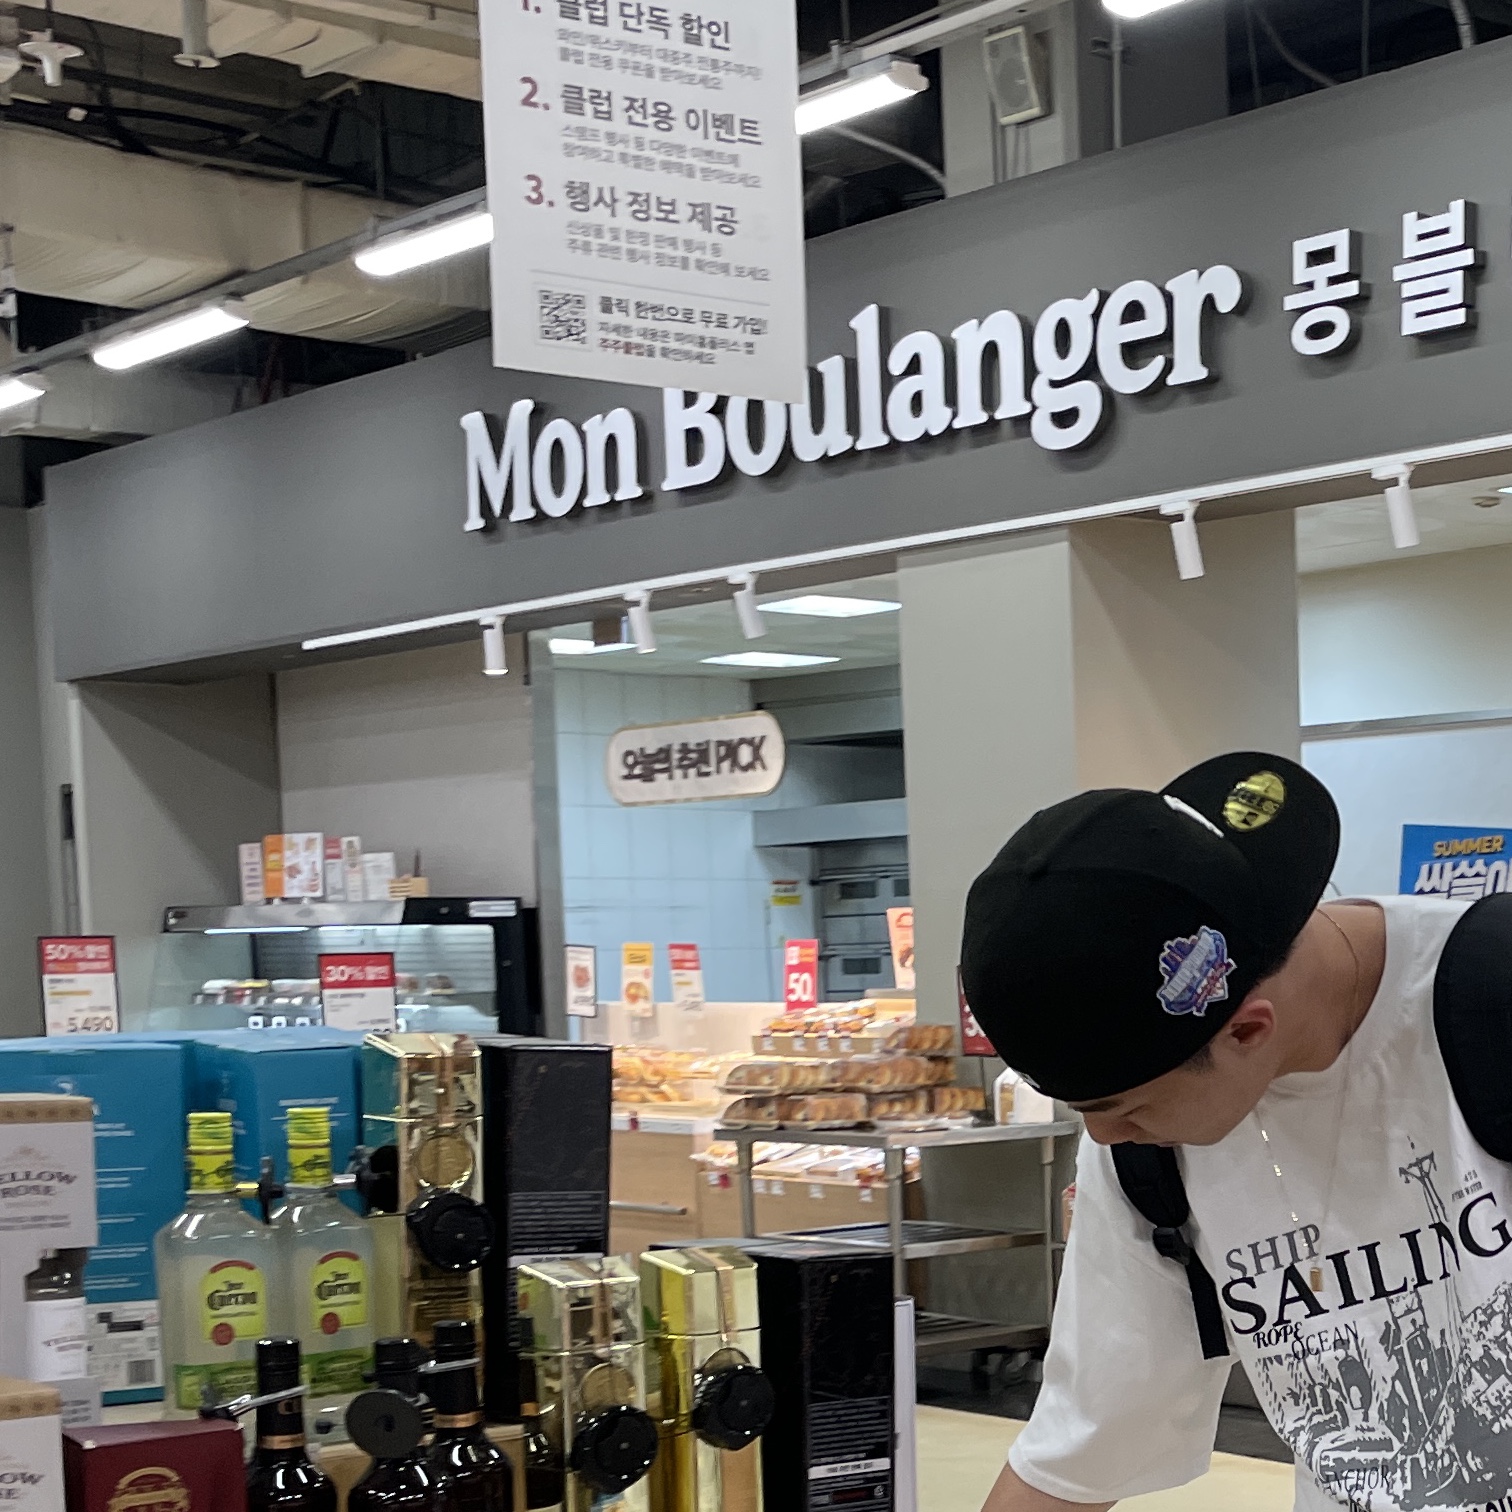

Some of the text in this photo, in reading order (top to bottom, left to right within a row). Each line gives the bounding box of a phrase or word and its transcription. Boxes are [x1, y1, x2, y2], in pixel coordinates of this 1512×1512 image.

[618, 1, 671, 40] 단독
[679, 13, 731, 51] 할인
[520, 77, 763, 145] 2. 클럽 전용 이벤트
[524, 174, 739, 236] 3. 행사 정보 제공
[460, 264, 1243, 532] Mon Boulanger
[1433, 835, 1504, 857] SUMMER
[787, 973, 813, 1002] 50
[1226, 1224, 1320, 1281] SHIP
[1253, 1322, 1304, 1349] ROPE
[1291, 1321, 1359, 1360] OCEAN
